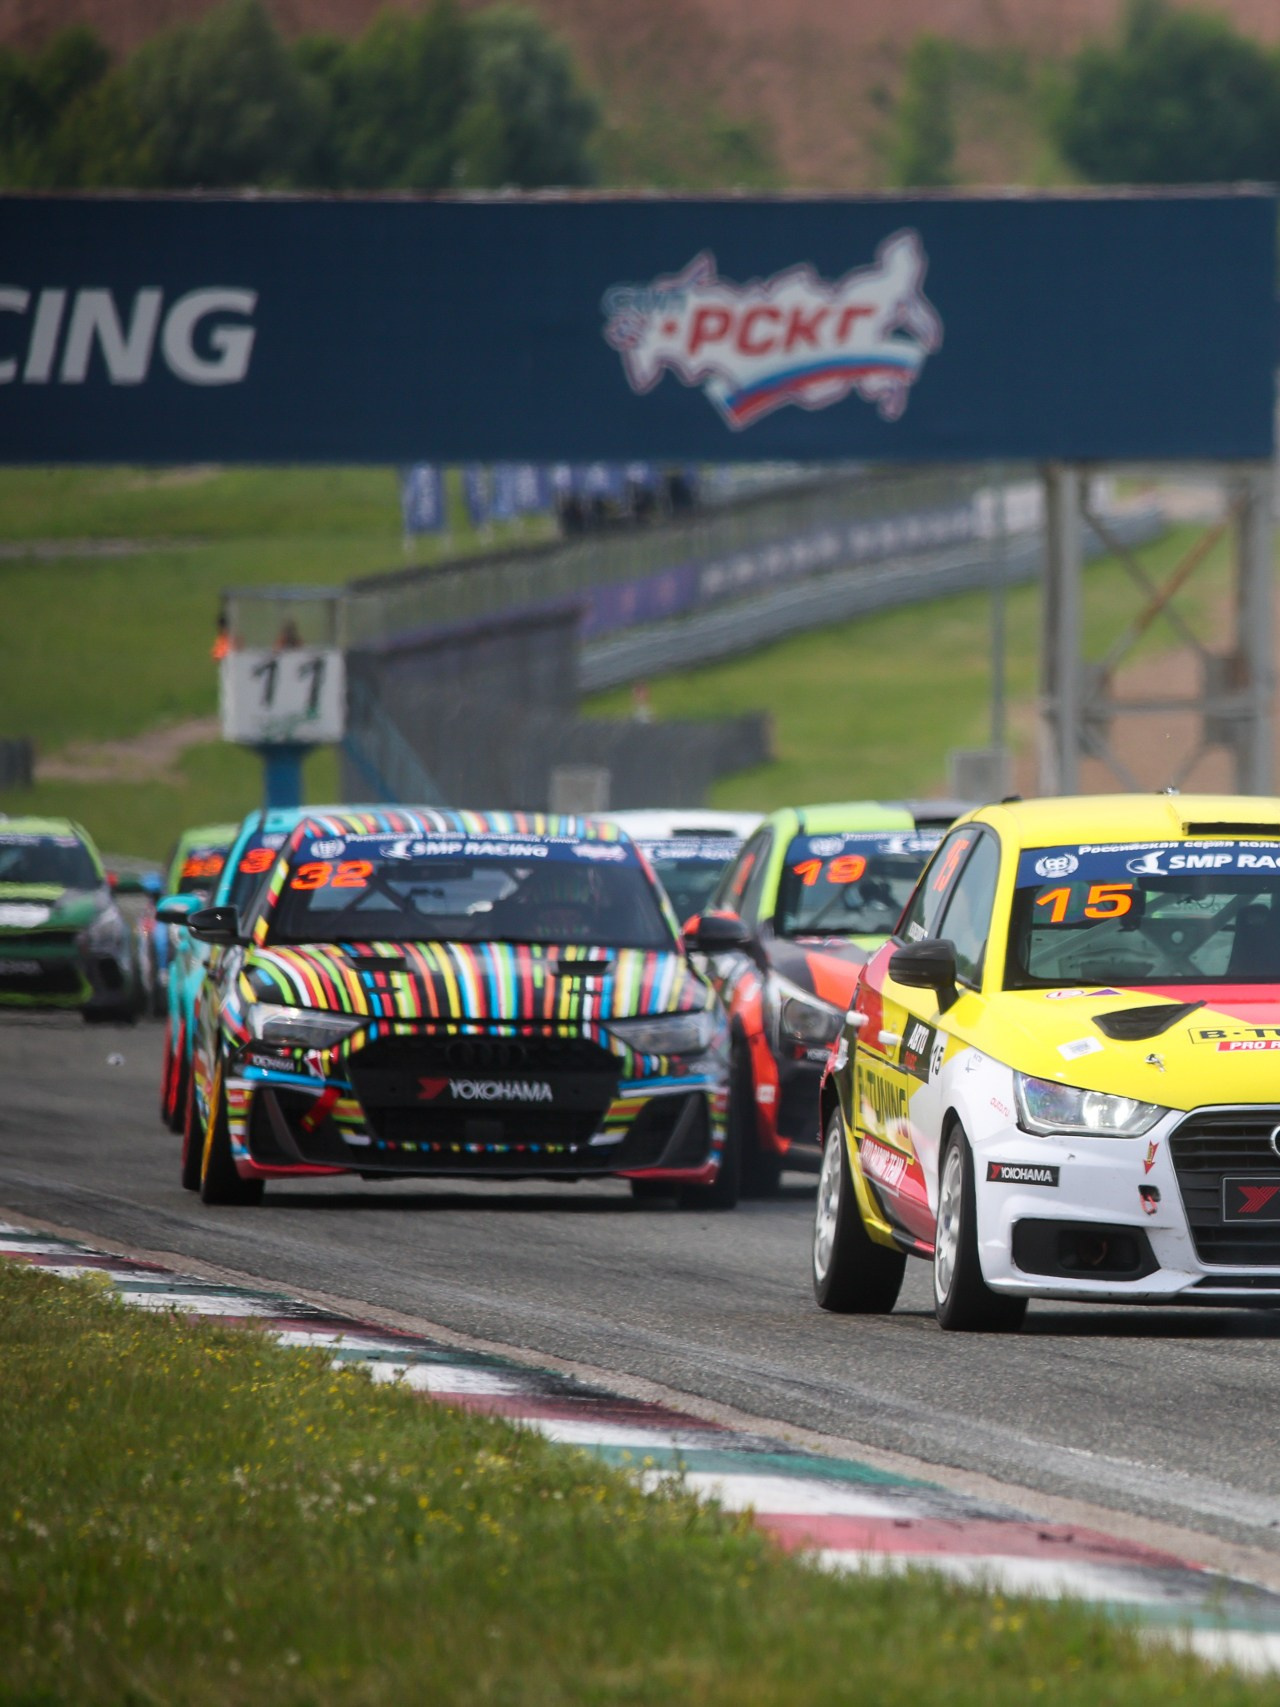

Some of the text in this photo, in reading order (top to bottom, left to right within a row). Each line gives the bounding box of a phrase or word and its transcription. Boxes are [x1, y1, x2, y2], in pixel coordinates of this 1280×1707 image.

[687, 304, 876, 356] РСКГ
[250, 656, 327, 713] 11
[465, 842, 549, 857] RACING
[1078, 841, 1179, 855] Российская
[1183, 840, 1234, 849] серия
[290, 860, 374, 890] 32
[792, 854, 866, 886] 19
[1168, 854, 1233, 869] SMP
[1036, 884, 1134, 923] 15
[1229, 1041, 1264, 1050] PRO
[931, 1045, 945, 1076] 15
[448, 1078, 553, 1102] YOKOHAMA
[1000, 1166, 1054, 1183] YOKOHAMA
